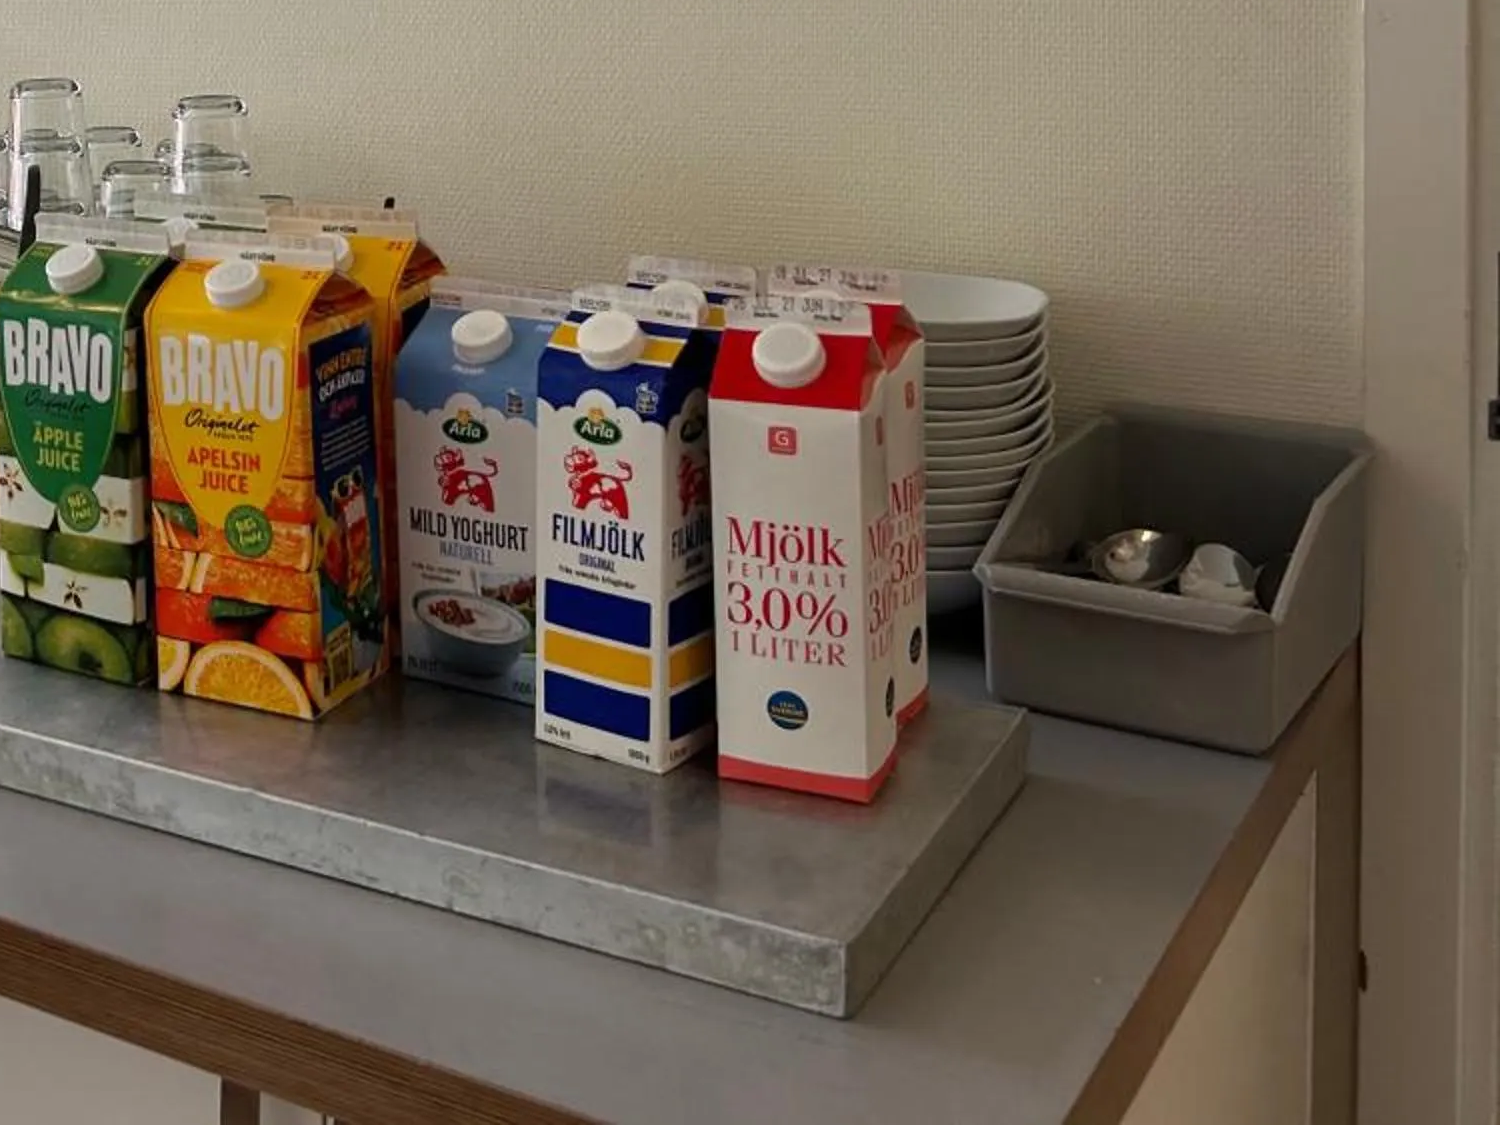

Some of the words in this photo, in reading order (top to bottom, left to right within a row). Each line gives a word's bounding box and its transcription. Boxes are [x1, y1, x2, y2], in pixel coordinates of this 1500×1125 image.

[3, 317, 113, 403] BRAVO
[159, 333, 285, 421] BRAVO
[450, 423, 481, 438] Arla
[580, 422, 615, 439] Arla
[36, 448, 81, 473] JUICE
[187, 446, 261, 473] APELSIN
[198, 469, 249, 494] JUICE
[410, 506, 447, 538] MILD
[451, 515, 529, 552] YOGHURT
[552, 513, 646, 562] FILMJÖLK
[726, 516, 847, 568] Mjölk
[727, 558, 847, 589] FETTHALT
[727, 580, 849, 638] 3,0%
[751, 632, 847, 668] LITER
